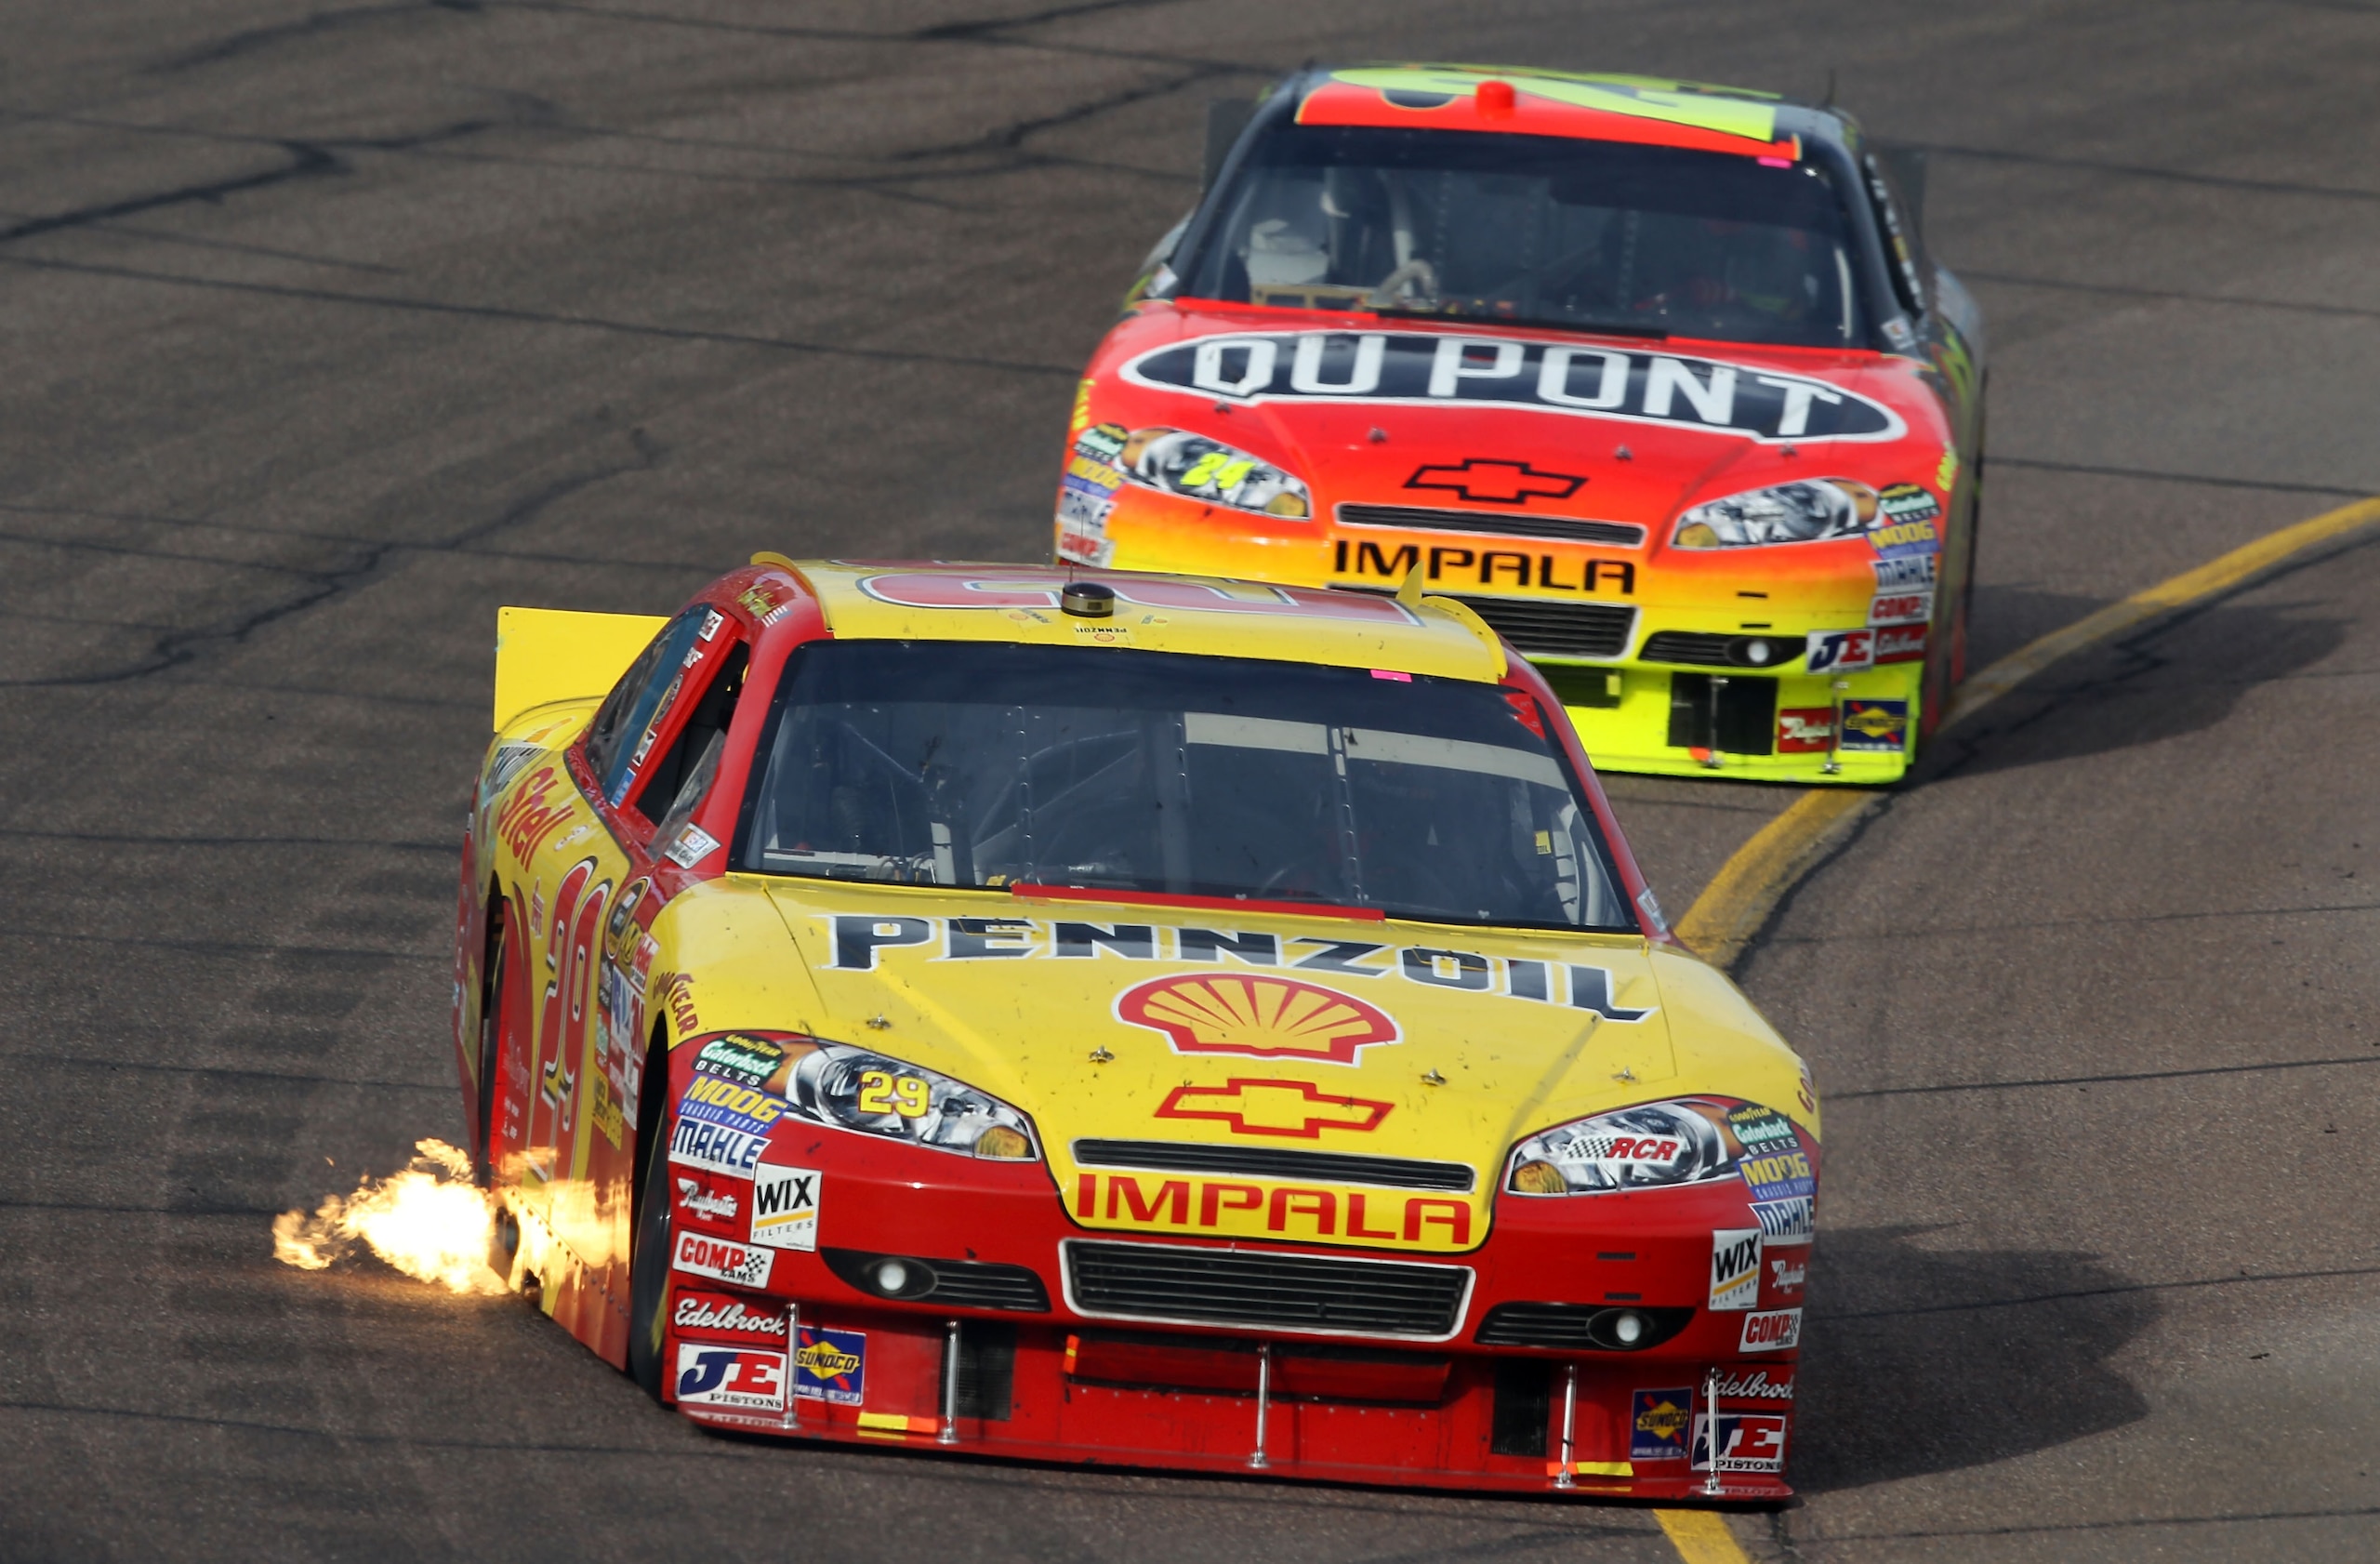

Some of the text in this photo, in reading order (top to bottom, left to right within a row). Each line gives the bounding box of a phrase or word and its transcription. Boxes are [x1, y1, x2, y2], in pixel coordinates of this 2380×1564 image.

[1179, 452, 1256, 490] 24
[1869, 520, 1935, 549] MOOG
[1335, 540, 1634, 595] IMPALA
[1808, 630, 1871, 669] JE
[496, 767, 575, 873] Shell
[826, 914, 1655, 1021] PENNZOIL
[694, 1059, 760, 1086] BELTS
[683, 1076, 788, 1122] MOOG
[857, 1070, 931, 1119] 29
[670, 1119, 768, 1170] MAHLE
[1606, 1137, 1678, 1160] RCR
[1749, 1136, 1798, 1155] BELTS
[1740, 1152, 1811, 1186] MOOG
[756, 1174, 815, 1215] WIX
[1077, 1173, 1471, 1245] IMPALA
[753, 1220, 813, 1239] FILTERS
[681, 1238, 746, 1271] COMP
[1714, 1233, 1758, 1283] WIX
[675, 1298, 786, 1335] Edelbrock
[1746, 1314, 1791, 1344] COMP
[680, 1352, 782, 1396] JE
[797, 1351, 855, 1372] SUNOCO
[708, 1393, 783, 1410] PISTONS
[1641, 1412, 1686, 1427] SUNOCO
